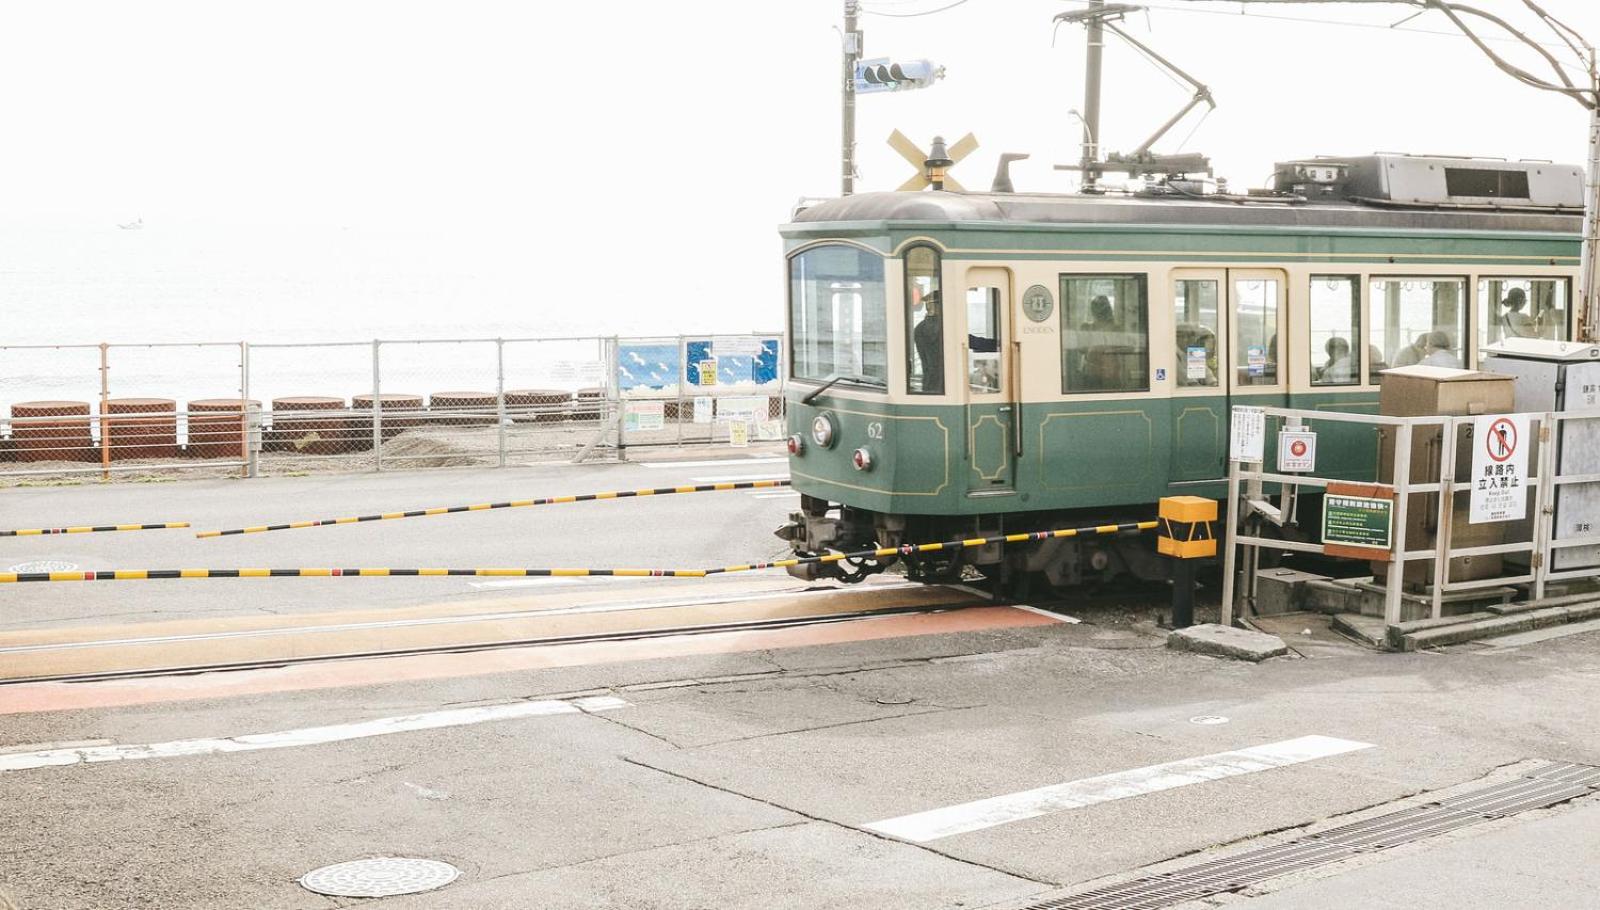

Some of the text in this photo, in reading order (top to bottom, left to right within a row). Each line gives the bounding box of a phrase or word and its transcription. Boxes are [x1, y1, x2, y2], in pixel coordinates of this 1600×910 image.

[867, 422, 883, 440] 62
[1484, 464, 1515, 477] 線路内
[1478, 476, 1519, 490] 立入禁止
